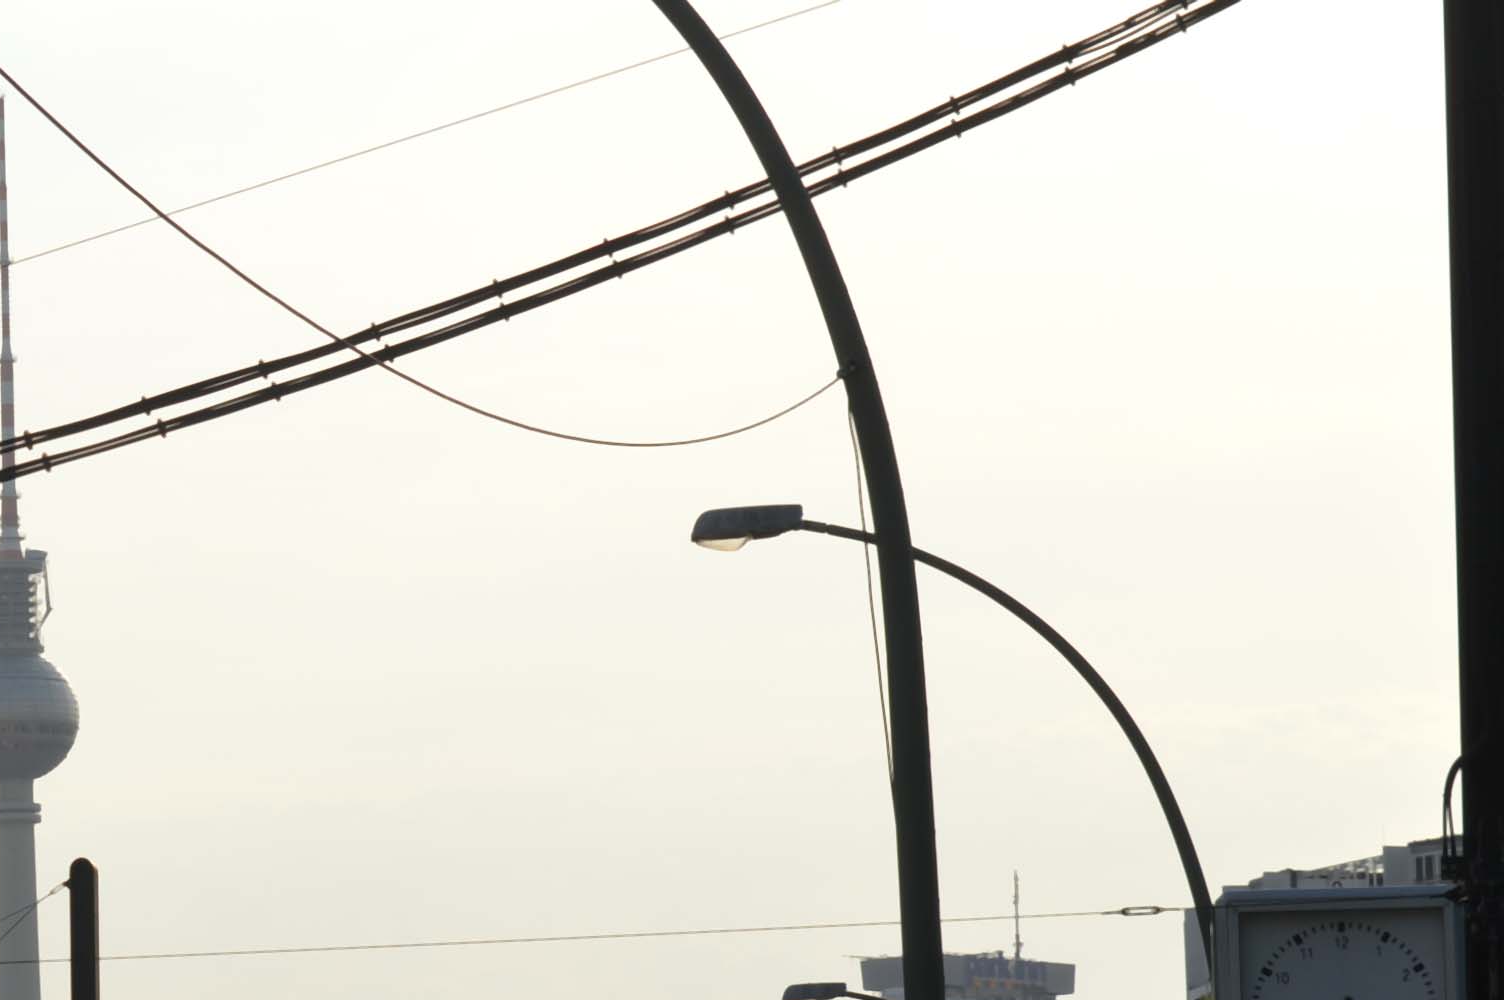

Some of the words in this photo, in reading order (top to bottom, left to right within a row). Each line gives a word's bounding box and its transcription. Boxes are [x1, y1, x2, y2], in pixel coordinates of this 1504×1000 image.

[1336, 936, 1349, 949] 12
[1300, 948, 1313, 959] 11
[1275, 972, 1290, 984] 10
[1402, 968, 1410, 982] 2
